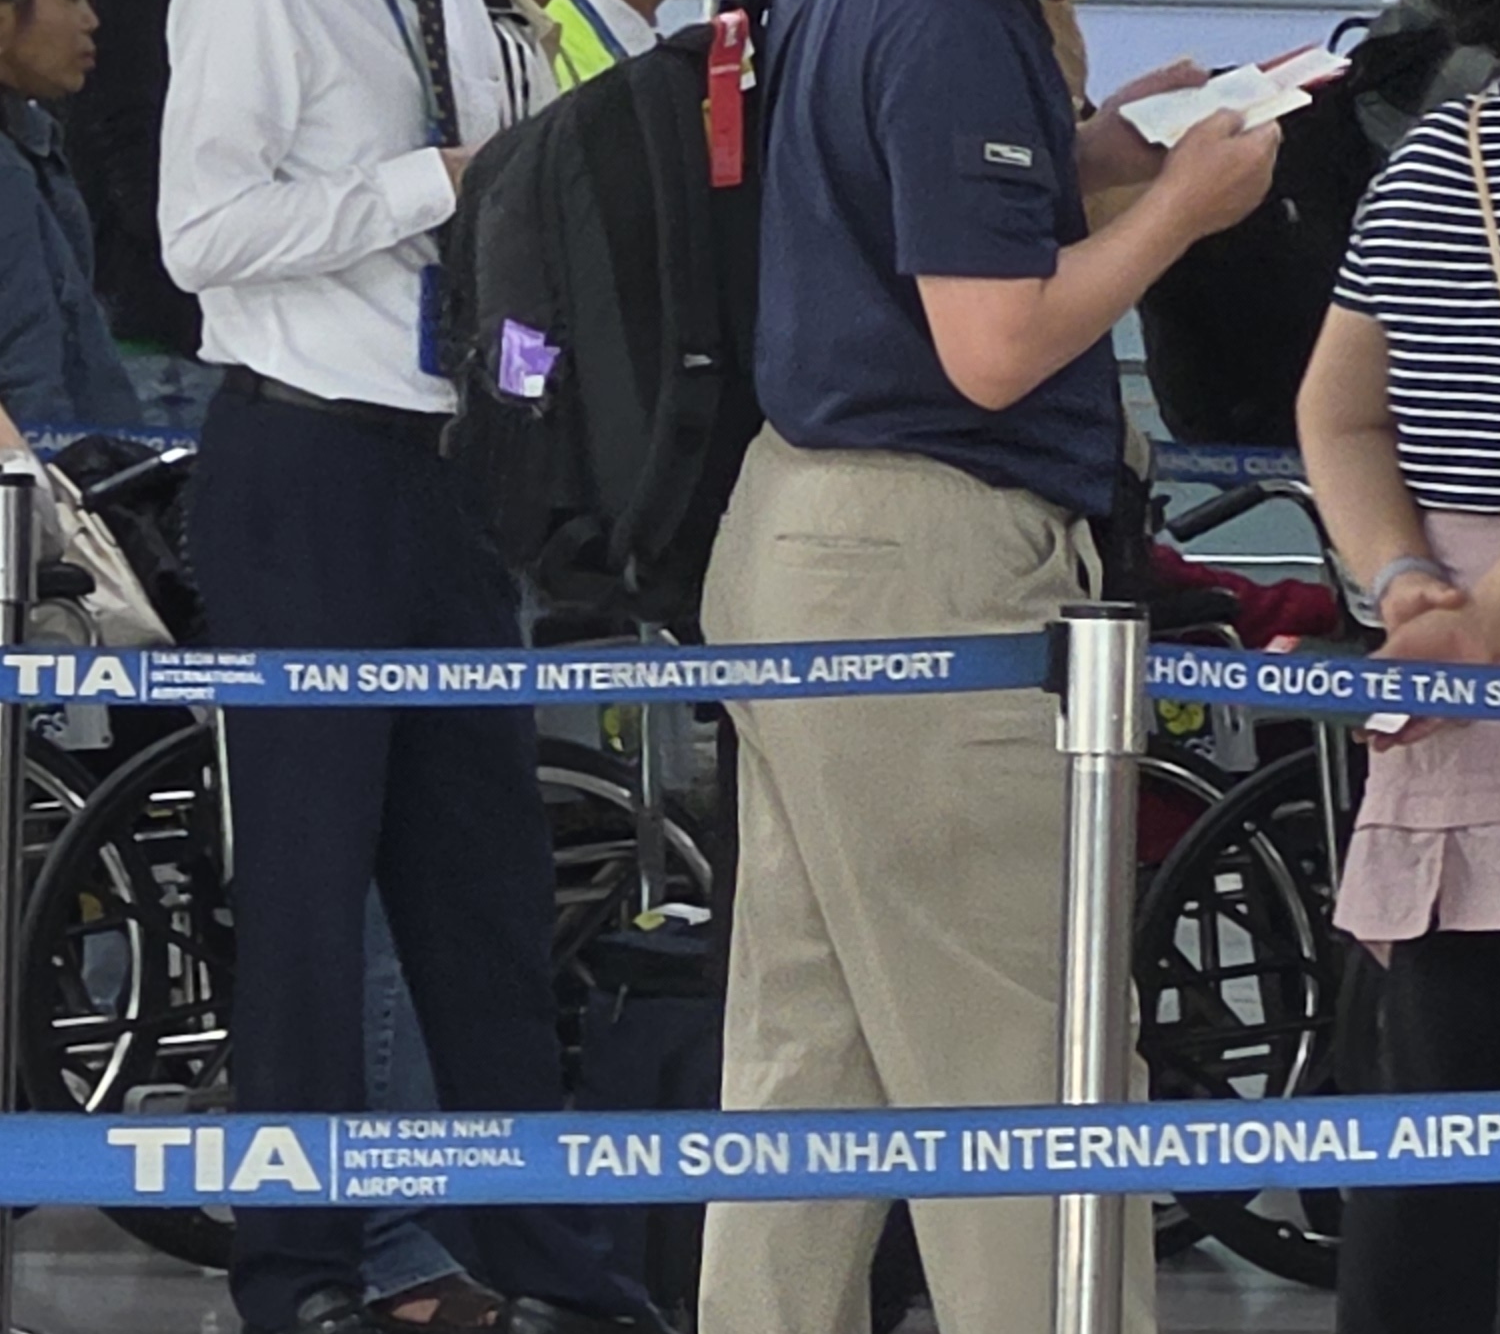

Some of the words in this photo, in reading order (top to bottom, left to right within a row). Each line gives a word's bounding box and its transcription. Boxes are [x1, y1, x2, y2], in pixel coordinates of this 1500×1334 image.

[3, 655, 136, 697] TIA
[283, 664, 349, 691] TAN
[358, 663, 430, 692] SON
[438, 663, 527, 691] NHAT
[536, 657, 801, 690] INTERNATIONAL
[808, 651, 955, 683] AIRPORT
[1257, 660, 1354, 697] QUỐC
[1411, 672, 1475, 706] TÂN
[345, 1119, 391, 1139] TAN
[397, 1118, 447, 1140] SON
[453, 1117, 515, 1139] NHAT
[558, 1133, 662, 1177] TAN
[678, 1131, 789, 1176] SON
[807, 1130, 947, 1173] NHAT
[961, 1117, 1378, 1171] INTERNATIONAL
[107, 1126, 322, 1192] TIA
[344, 1147, 526, 1169] INTERNATIONAL
[345, 1174, 449, 1198] AIRPORT
